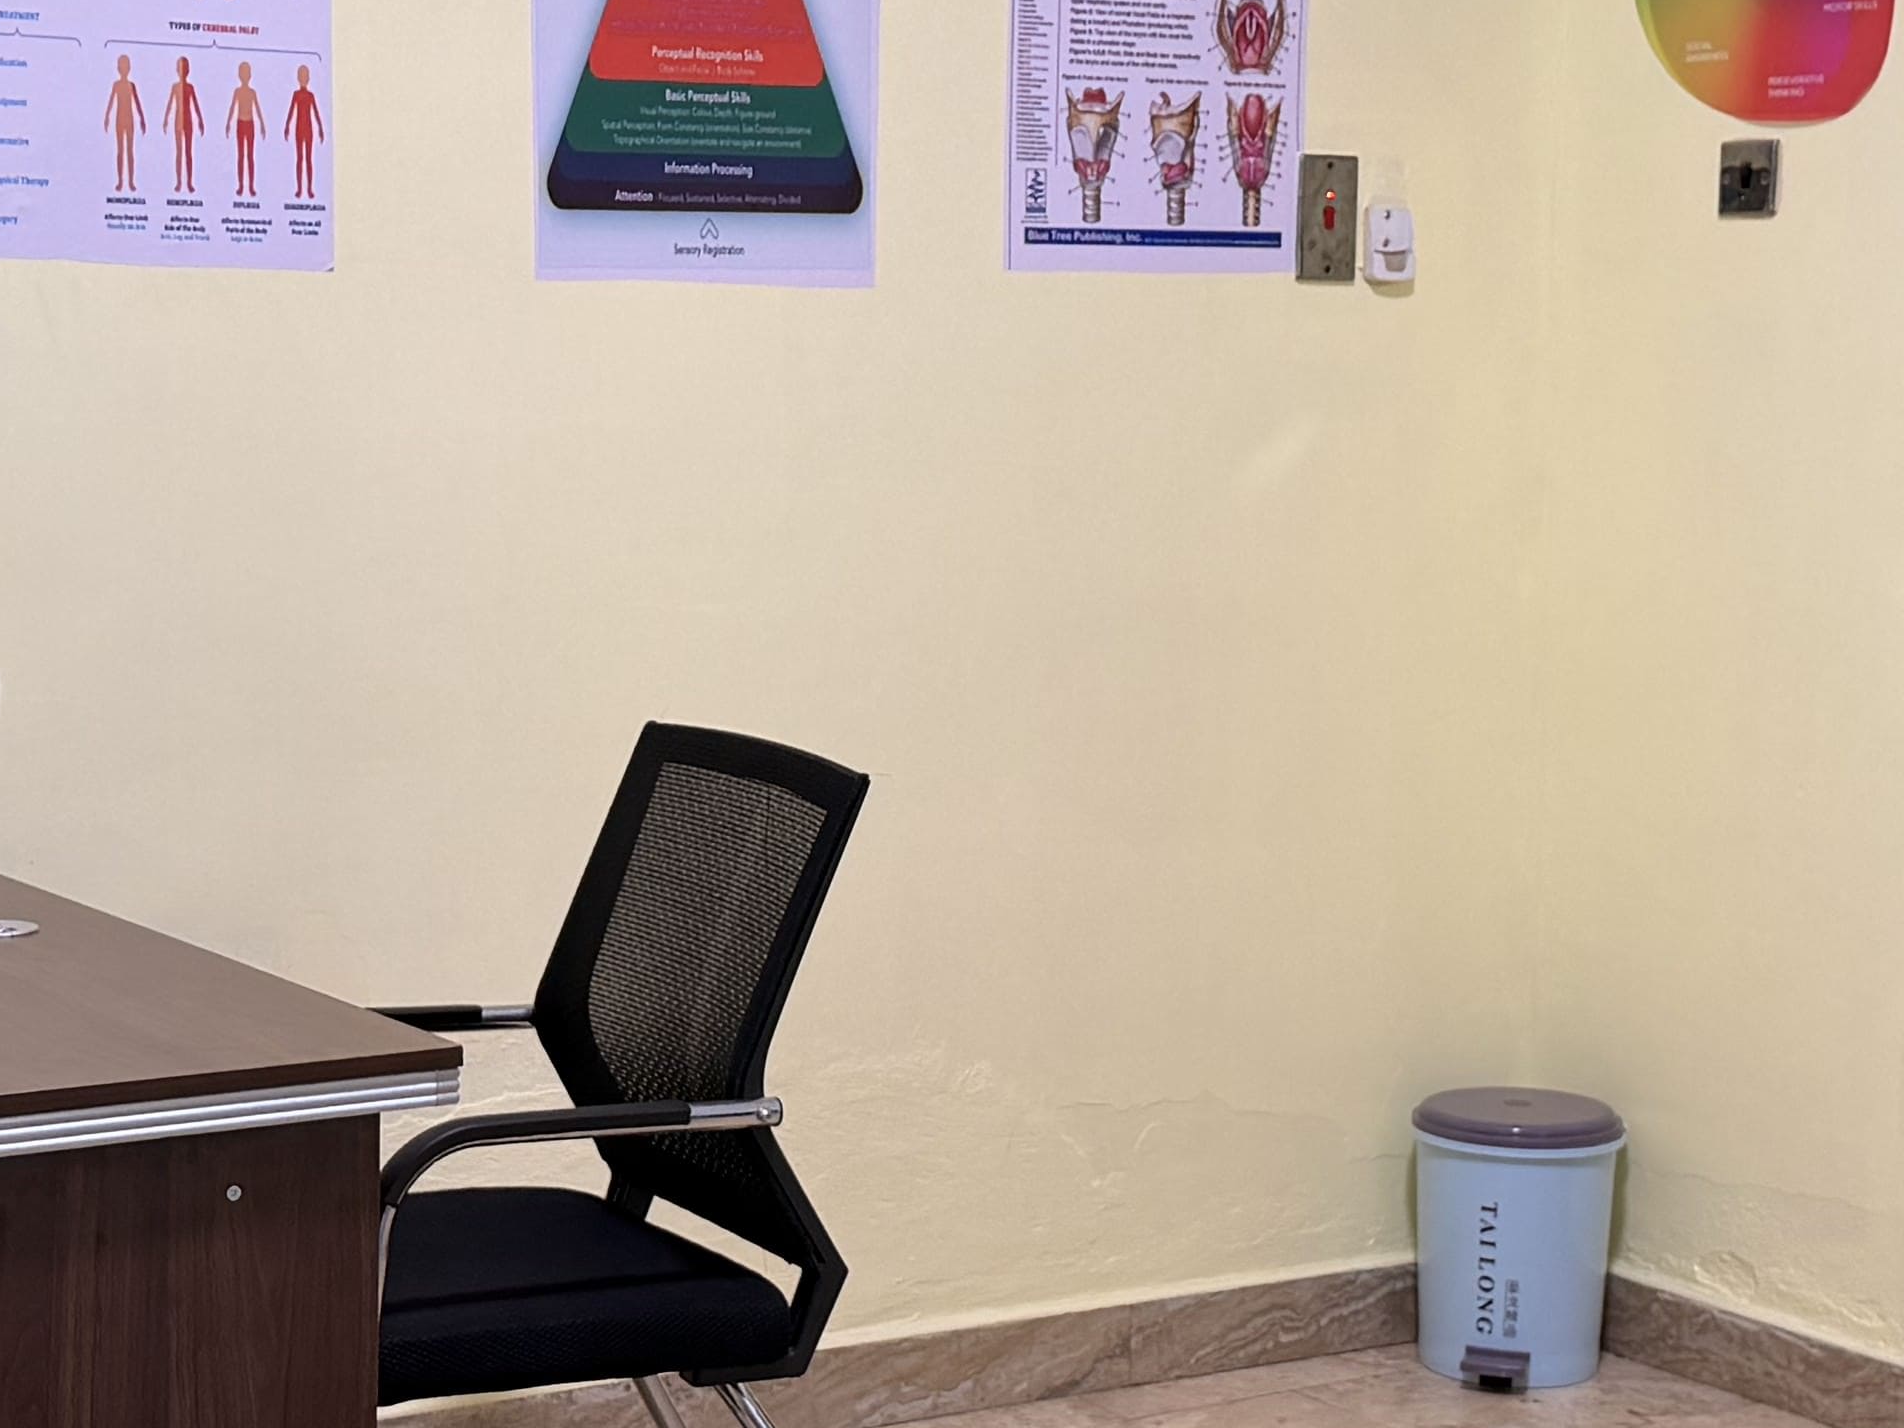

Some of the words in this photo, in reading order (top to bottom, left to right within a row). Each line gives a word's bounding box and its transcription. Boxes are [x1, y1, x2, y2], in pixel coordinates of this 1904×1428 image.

[652, 46, 695, 60] Perceptual
[696, 47, 742, 62] Recognition
[744, 49, 764, 63] Skills
[665, 89, 686, 103] Basic
[688, 90, 730, 105] Perceptual
[732, 91, 751, 104] Skills
[664, 162, 710, 175] Information
[712, 164, 753, 178] Processing
[615, 190, 654, 203] Attention
[1027, 230, 1049, 243] Blue
[1051, 231, 1072, 243] Tree
[1074, 231, 1123, 247] Publishing,
[1125, 233, 1143, 245] Inc.
